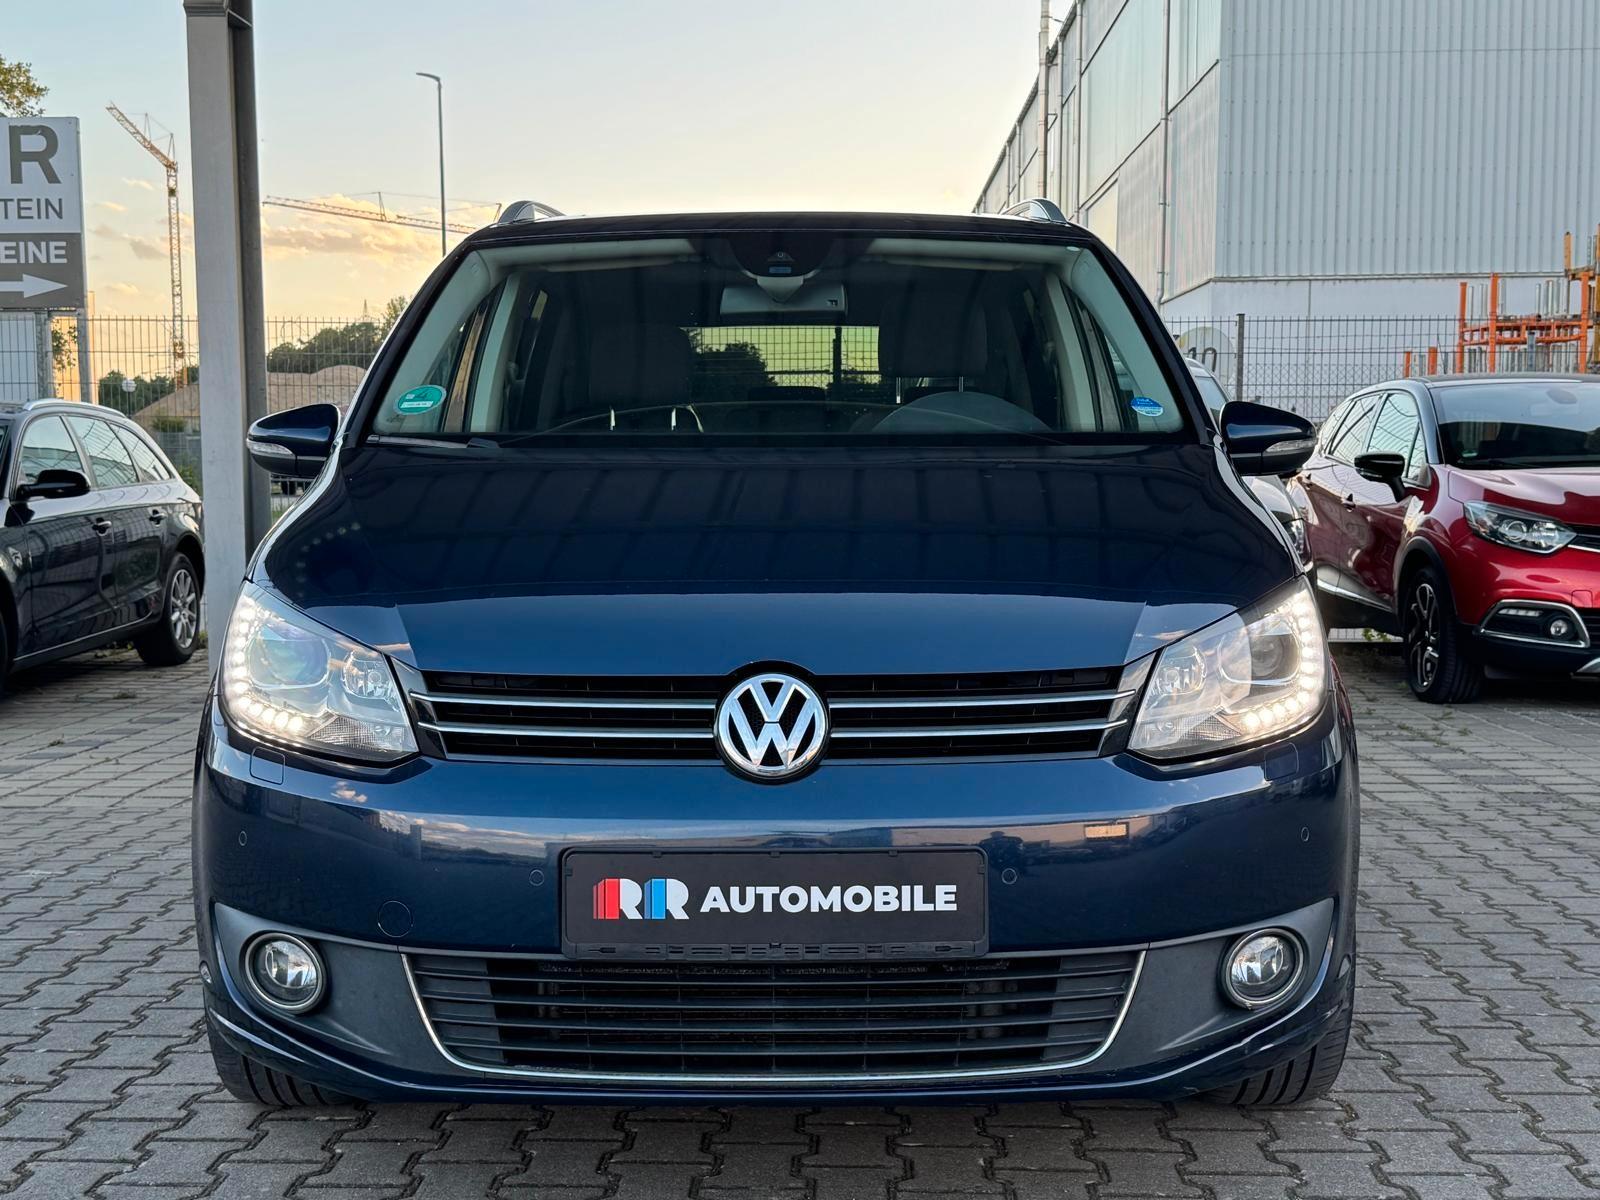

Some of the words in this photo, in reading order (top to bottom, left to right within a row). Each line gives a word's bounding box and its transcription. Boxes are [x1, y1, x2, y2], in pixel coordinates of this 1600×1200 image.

[8, 125, 61, 184] R
[0, 198, 63, 220] TEIN
[0, 241, 67, 264] EINE
[719, 674, 825, 775] VW
[700, 884, 958, 913] AUTOMOBILE
